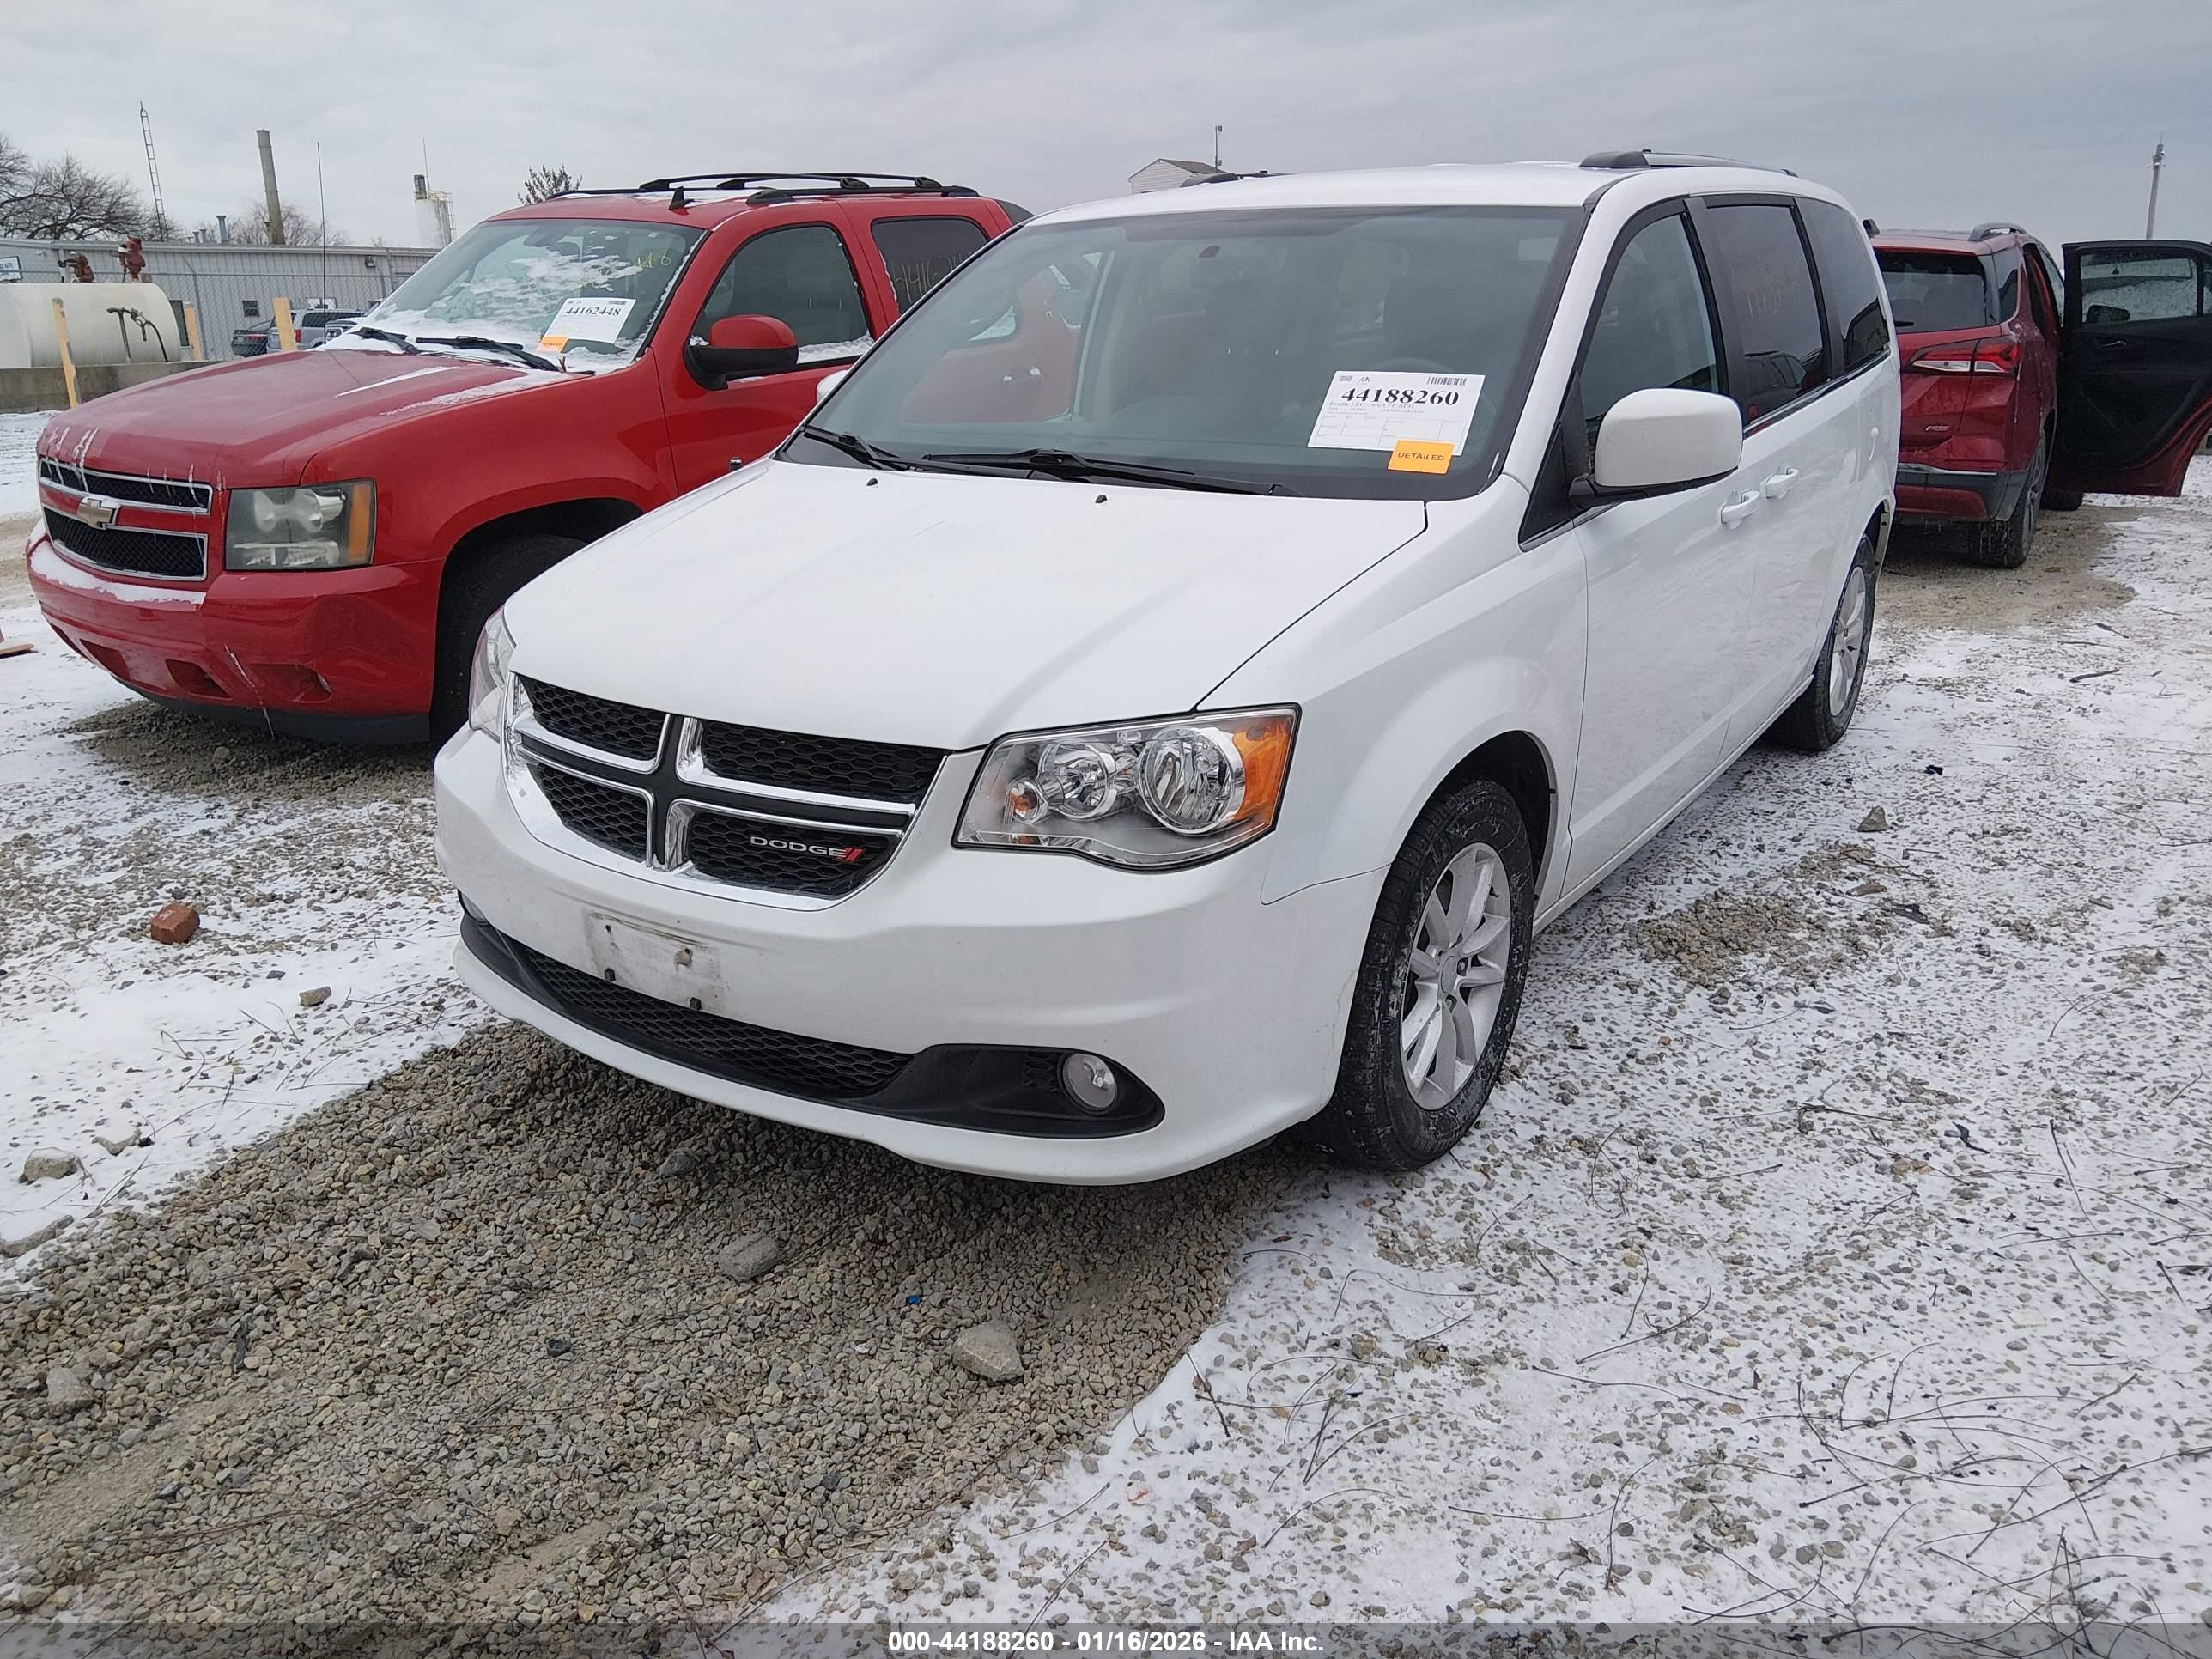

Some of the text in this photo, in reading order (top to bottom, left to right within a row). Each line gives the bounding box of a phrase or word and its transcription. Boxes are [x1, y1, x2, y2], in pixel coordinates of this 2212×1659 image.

[565, 307, 622, 317] 44162448
[1341, 387, 1460, 406] 44188260
[1398, 451, 1445, 461] DETAILED
[750, 836, 848, 858] DODGE
